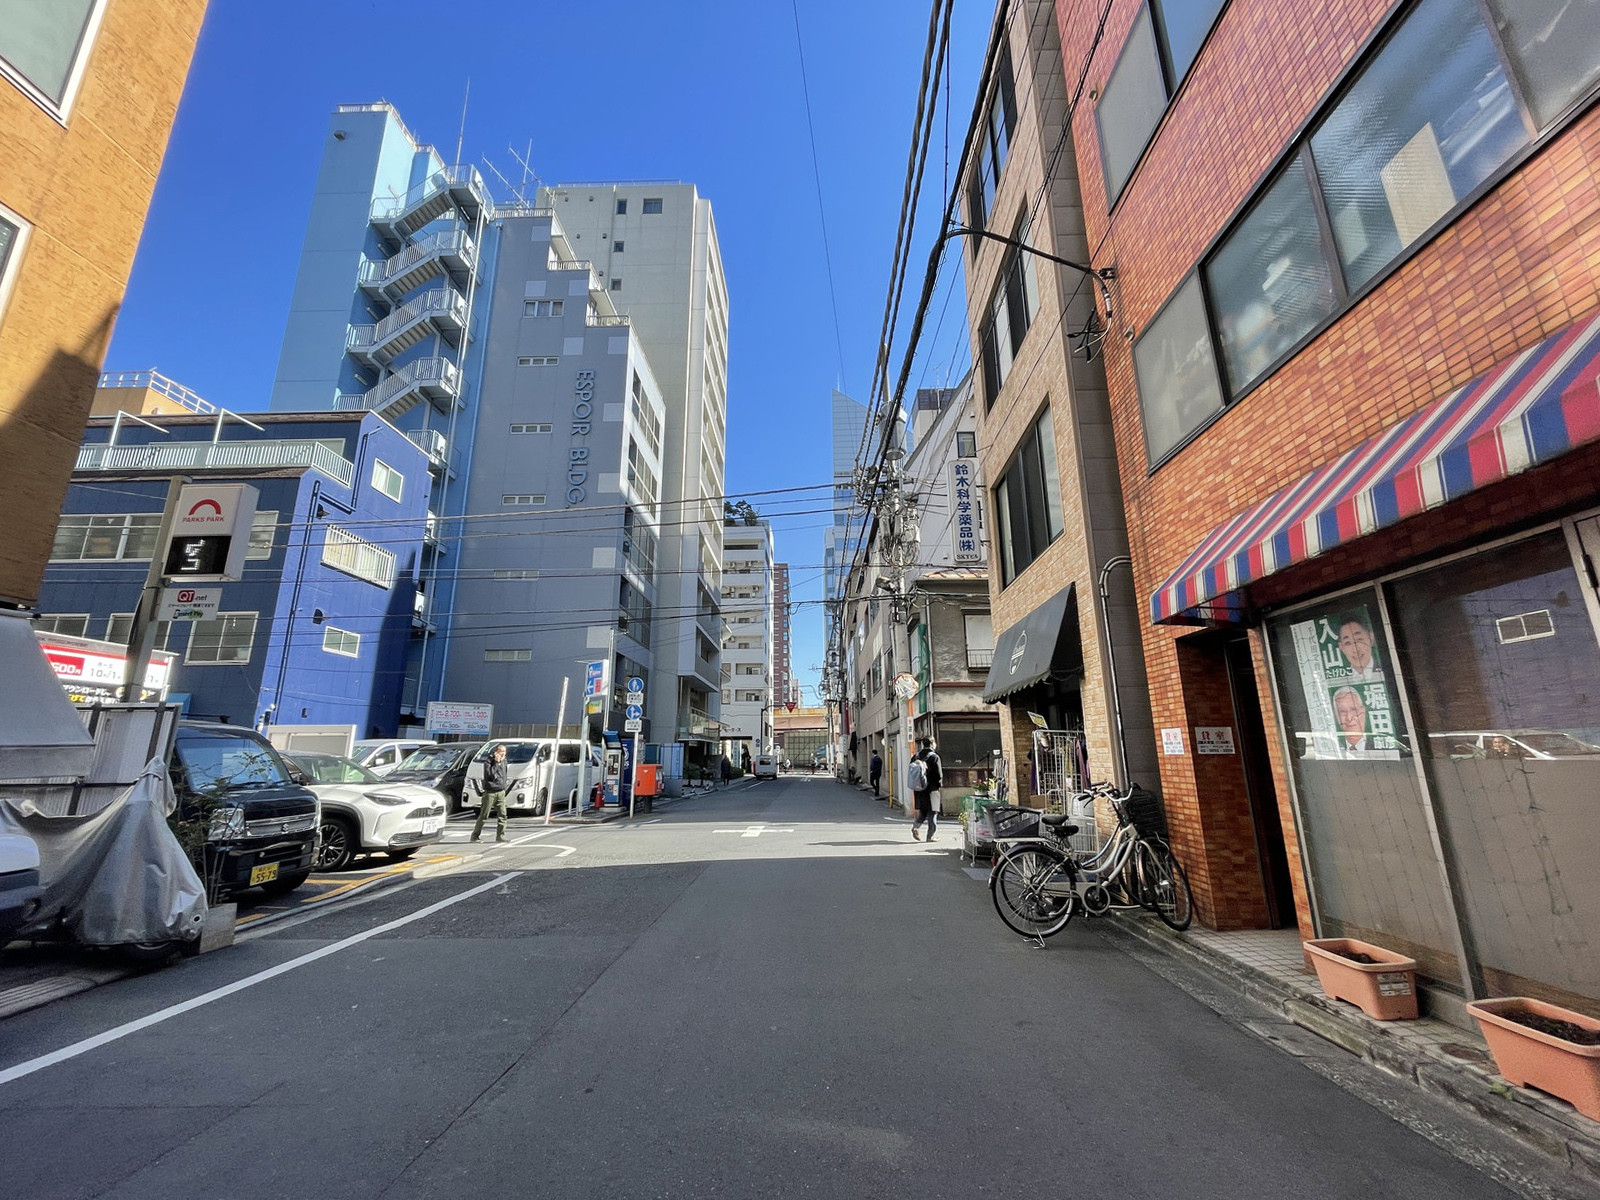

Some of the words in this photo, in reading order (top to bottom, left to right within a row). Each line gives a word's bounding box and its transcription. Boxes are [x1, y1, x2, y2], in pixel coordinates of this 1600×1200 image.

[572, 370, 595, 435] ESPOIR
[955, 464, 975, 551] 鈴木科学薬品(株)
[1319, 618, 1344, 667] 入山
[1325, 667, 1353, 678] たけひこ
[1364, 683, 1394, 734] 堀田
